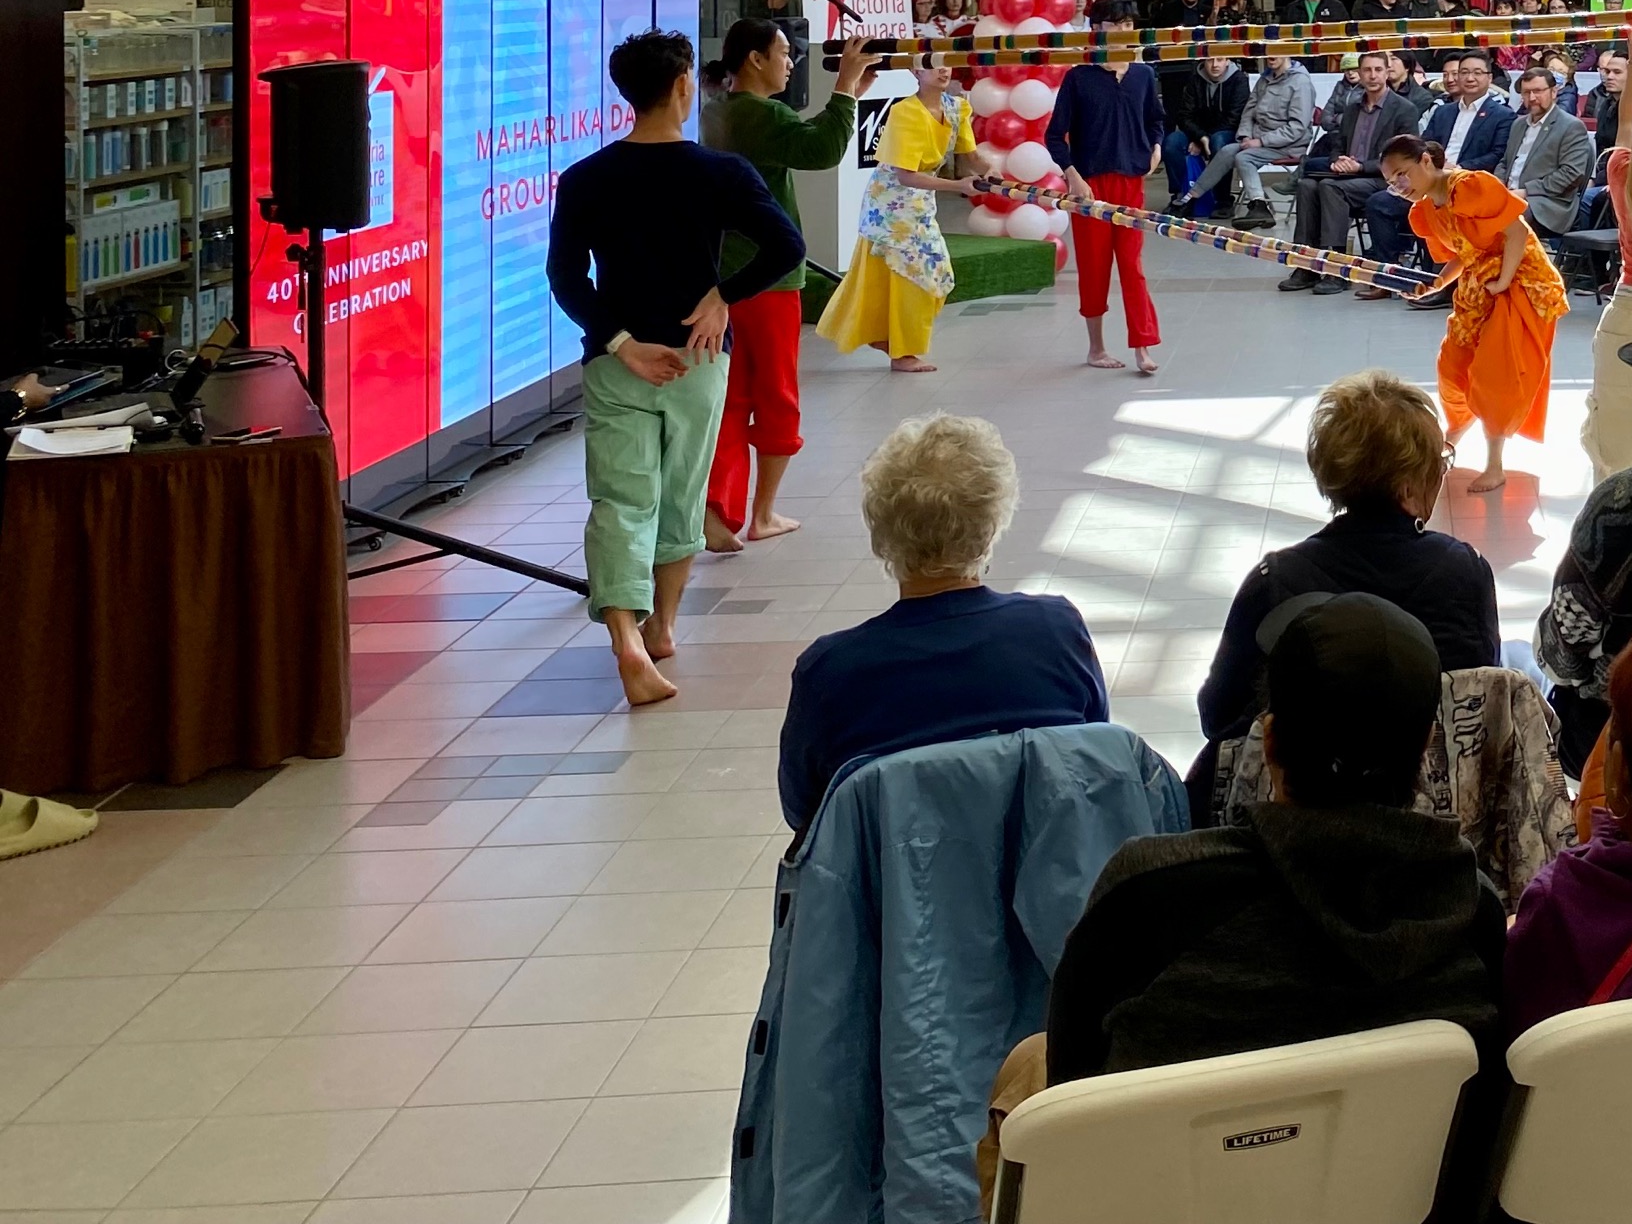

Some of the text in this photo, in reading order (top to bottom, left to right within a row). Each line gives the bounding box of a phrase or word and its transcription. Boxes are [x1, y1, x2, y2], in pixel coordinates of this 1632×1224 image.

[476, 107, 603, 162] MAHARLIKA
[481, 170, 560, 220] GROUP
[323, 239, 429, 289] NNIVERSARY
[293, 277, 412, 334] CEBRATION
[1233, 1128, 1291, 1147] LIFETIME
